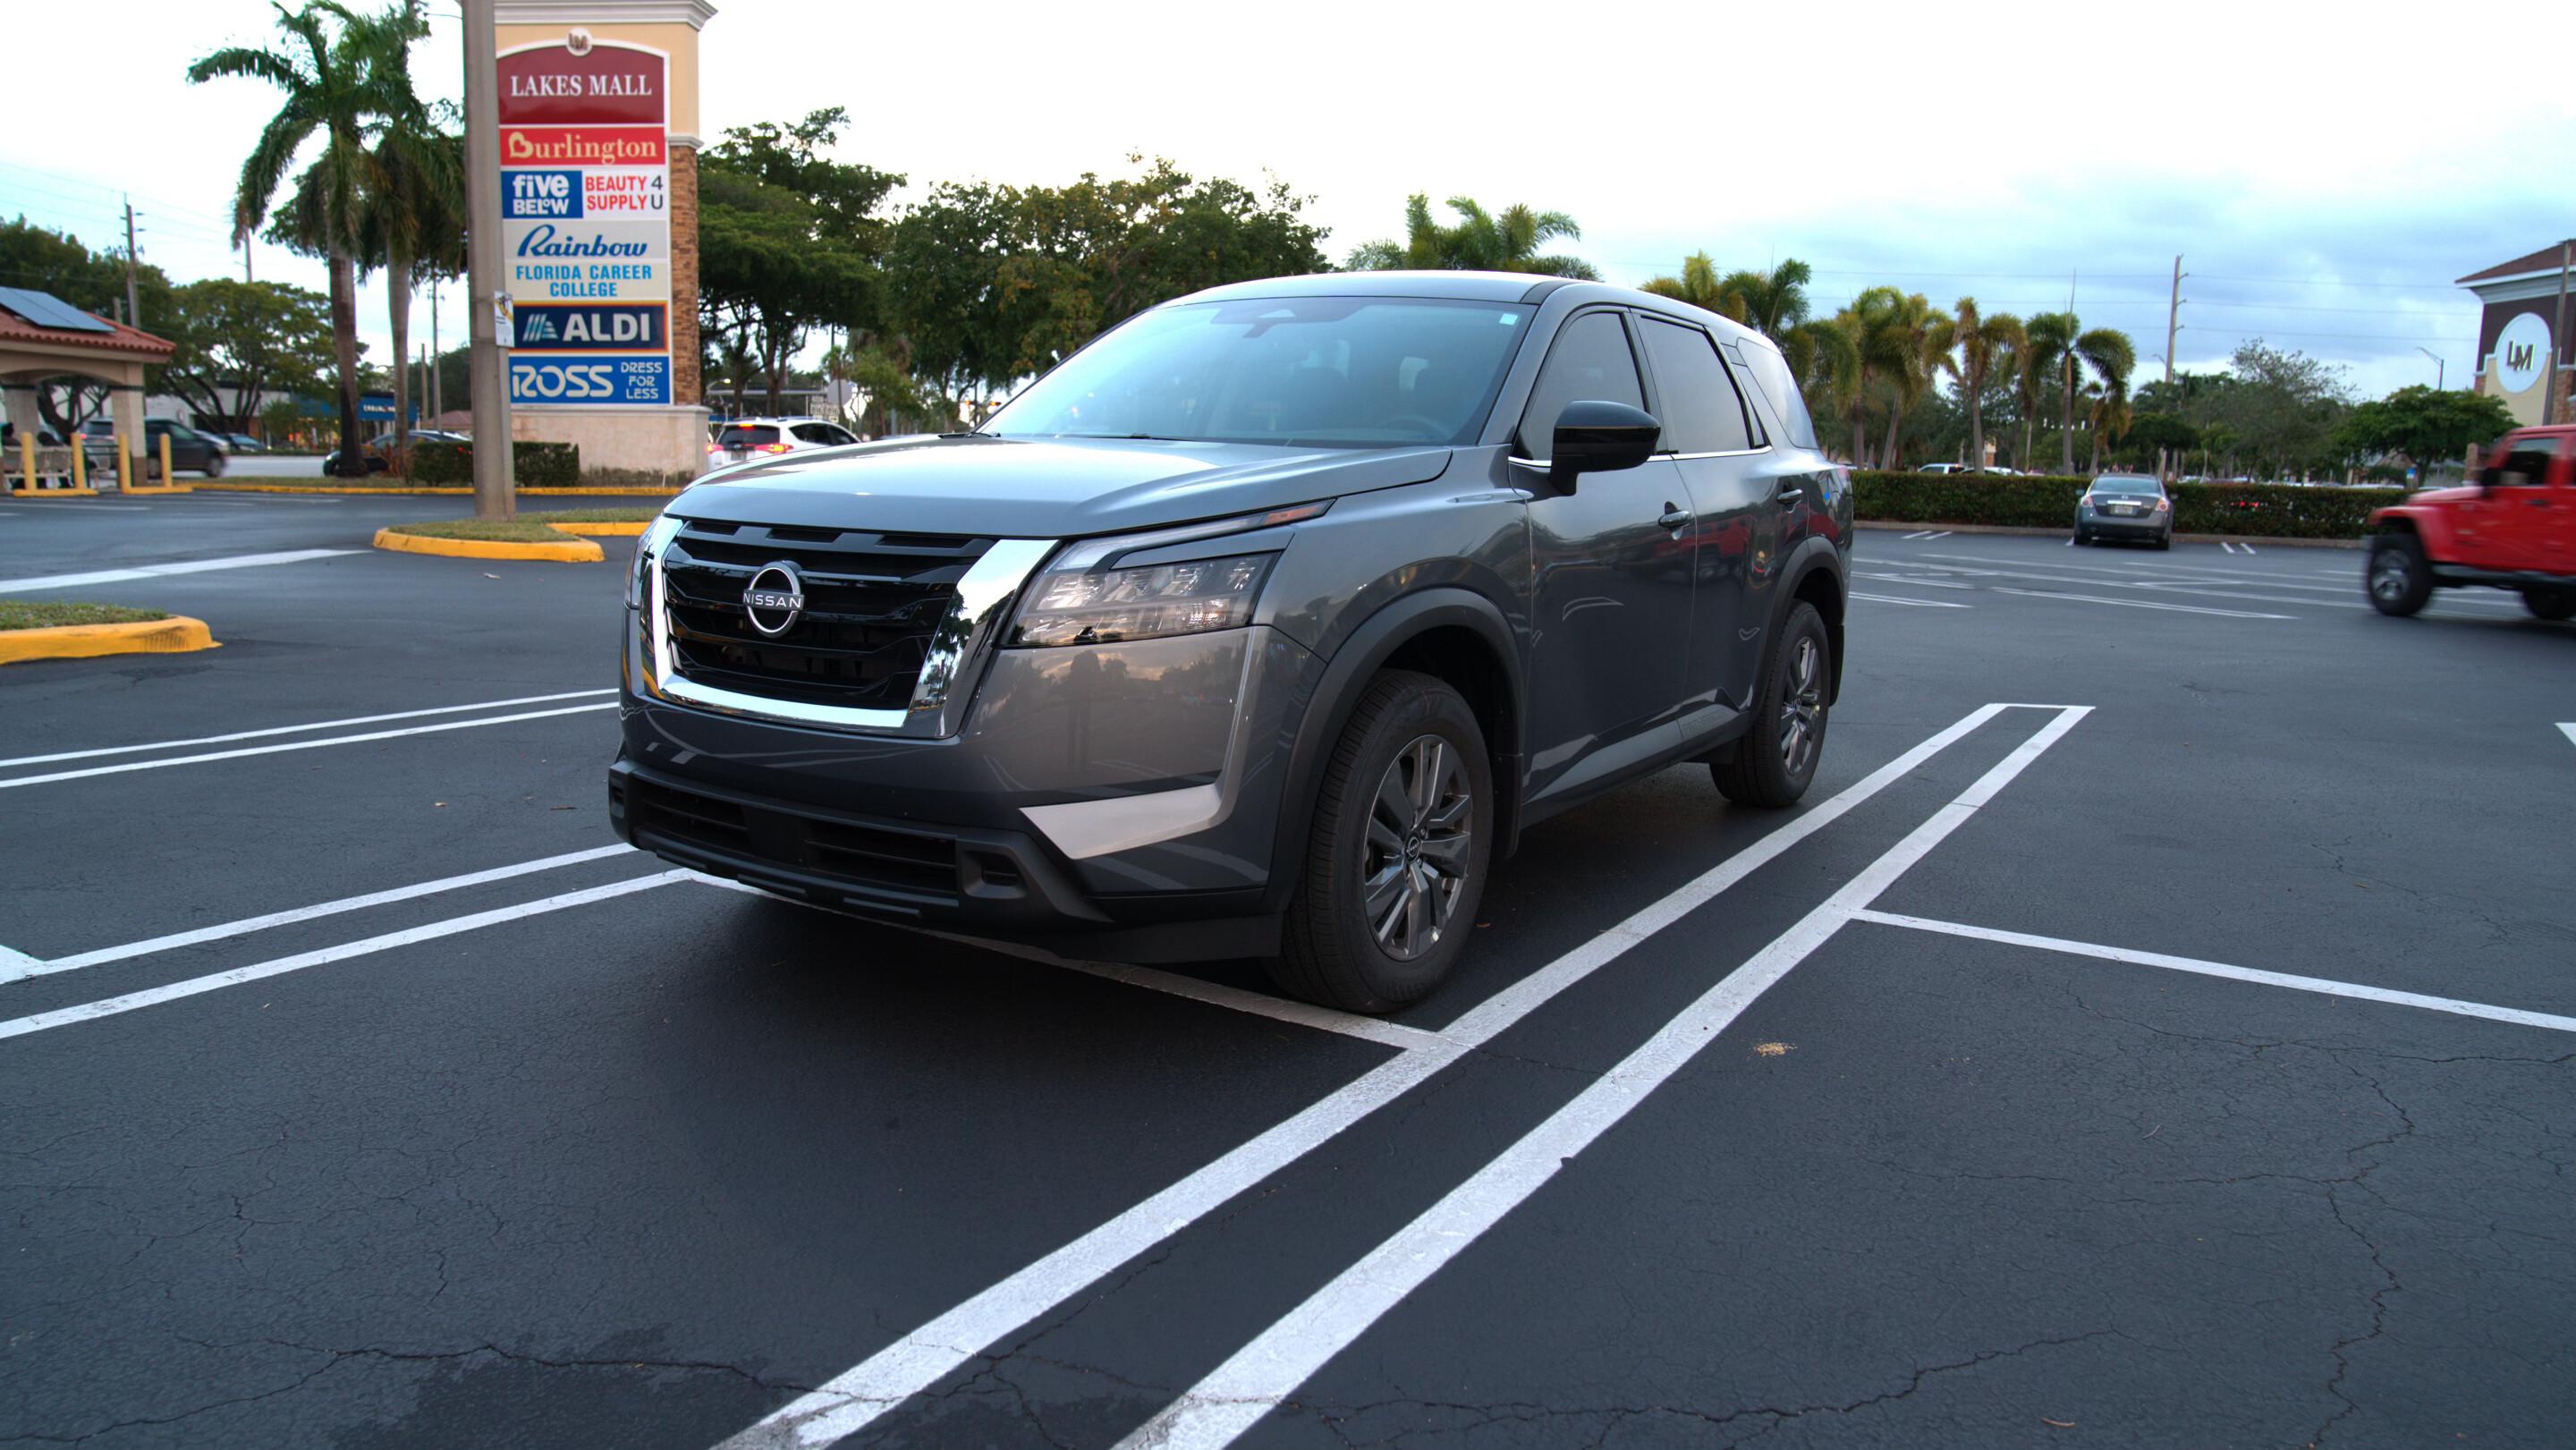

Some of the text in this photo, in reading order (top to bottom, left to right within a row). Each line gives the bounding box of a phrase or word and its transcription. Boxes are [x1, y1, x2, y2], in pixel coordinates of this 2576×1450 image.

[511, 74, 652, 97] LAKES MALL
[508, 131, 657, 165] Burlington
[513, 174, 570, 198] five
[585, 175, 663, 191] BEAUTY 4
[587, 194, 663, 210] SUPPLY U
[517, 224, 648, 257] Rainbow
[516, 265, 652, 280] FLORIDA CAREER
[550, 283, 617, 297] COLLEGE
[562, 313, 650, 342] ALDI
[2507, 341, 2534, 371] LM
[621, 362, 663, 373] DRESS
[512, 365, 614, 397] ROSS
[629, 376, 655, 386] FOR
[626, 388, 659, 399] LESS
[743, 592, 801, 608] NISSAN
